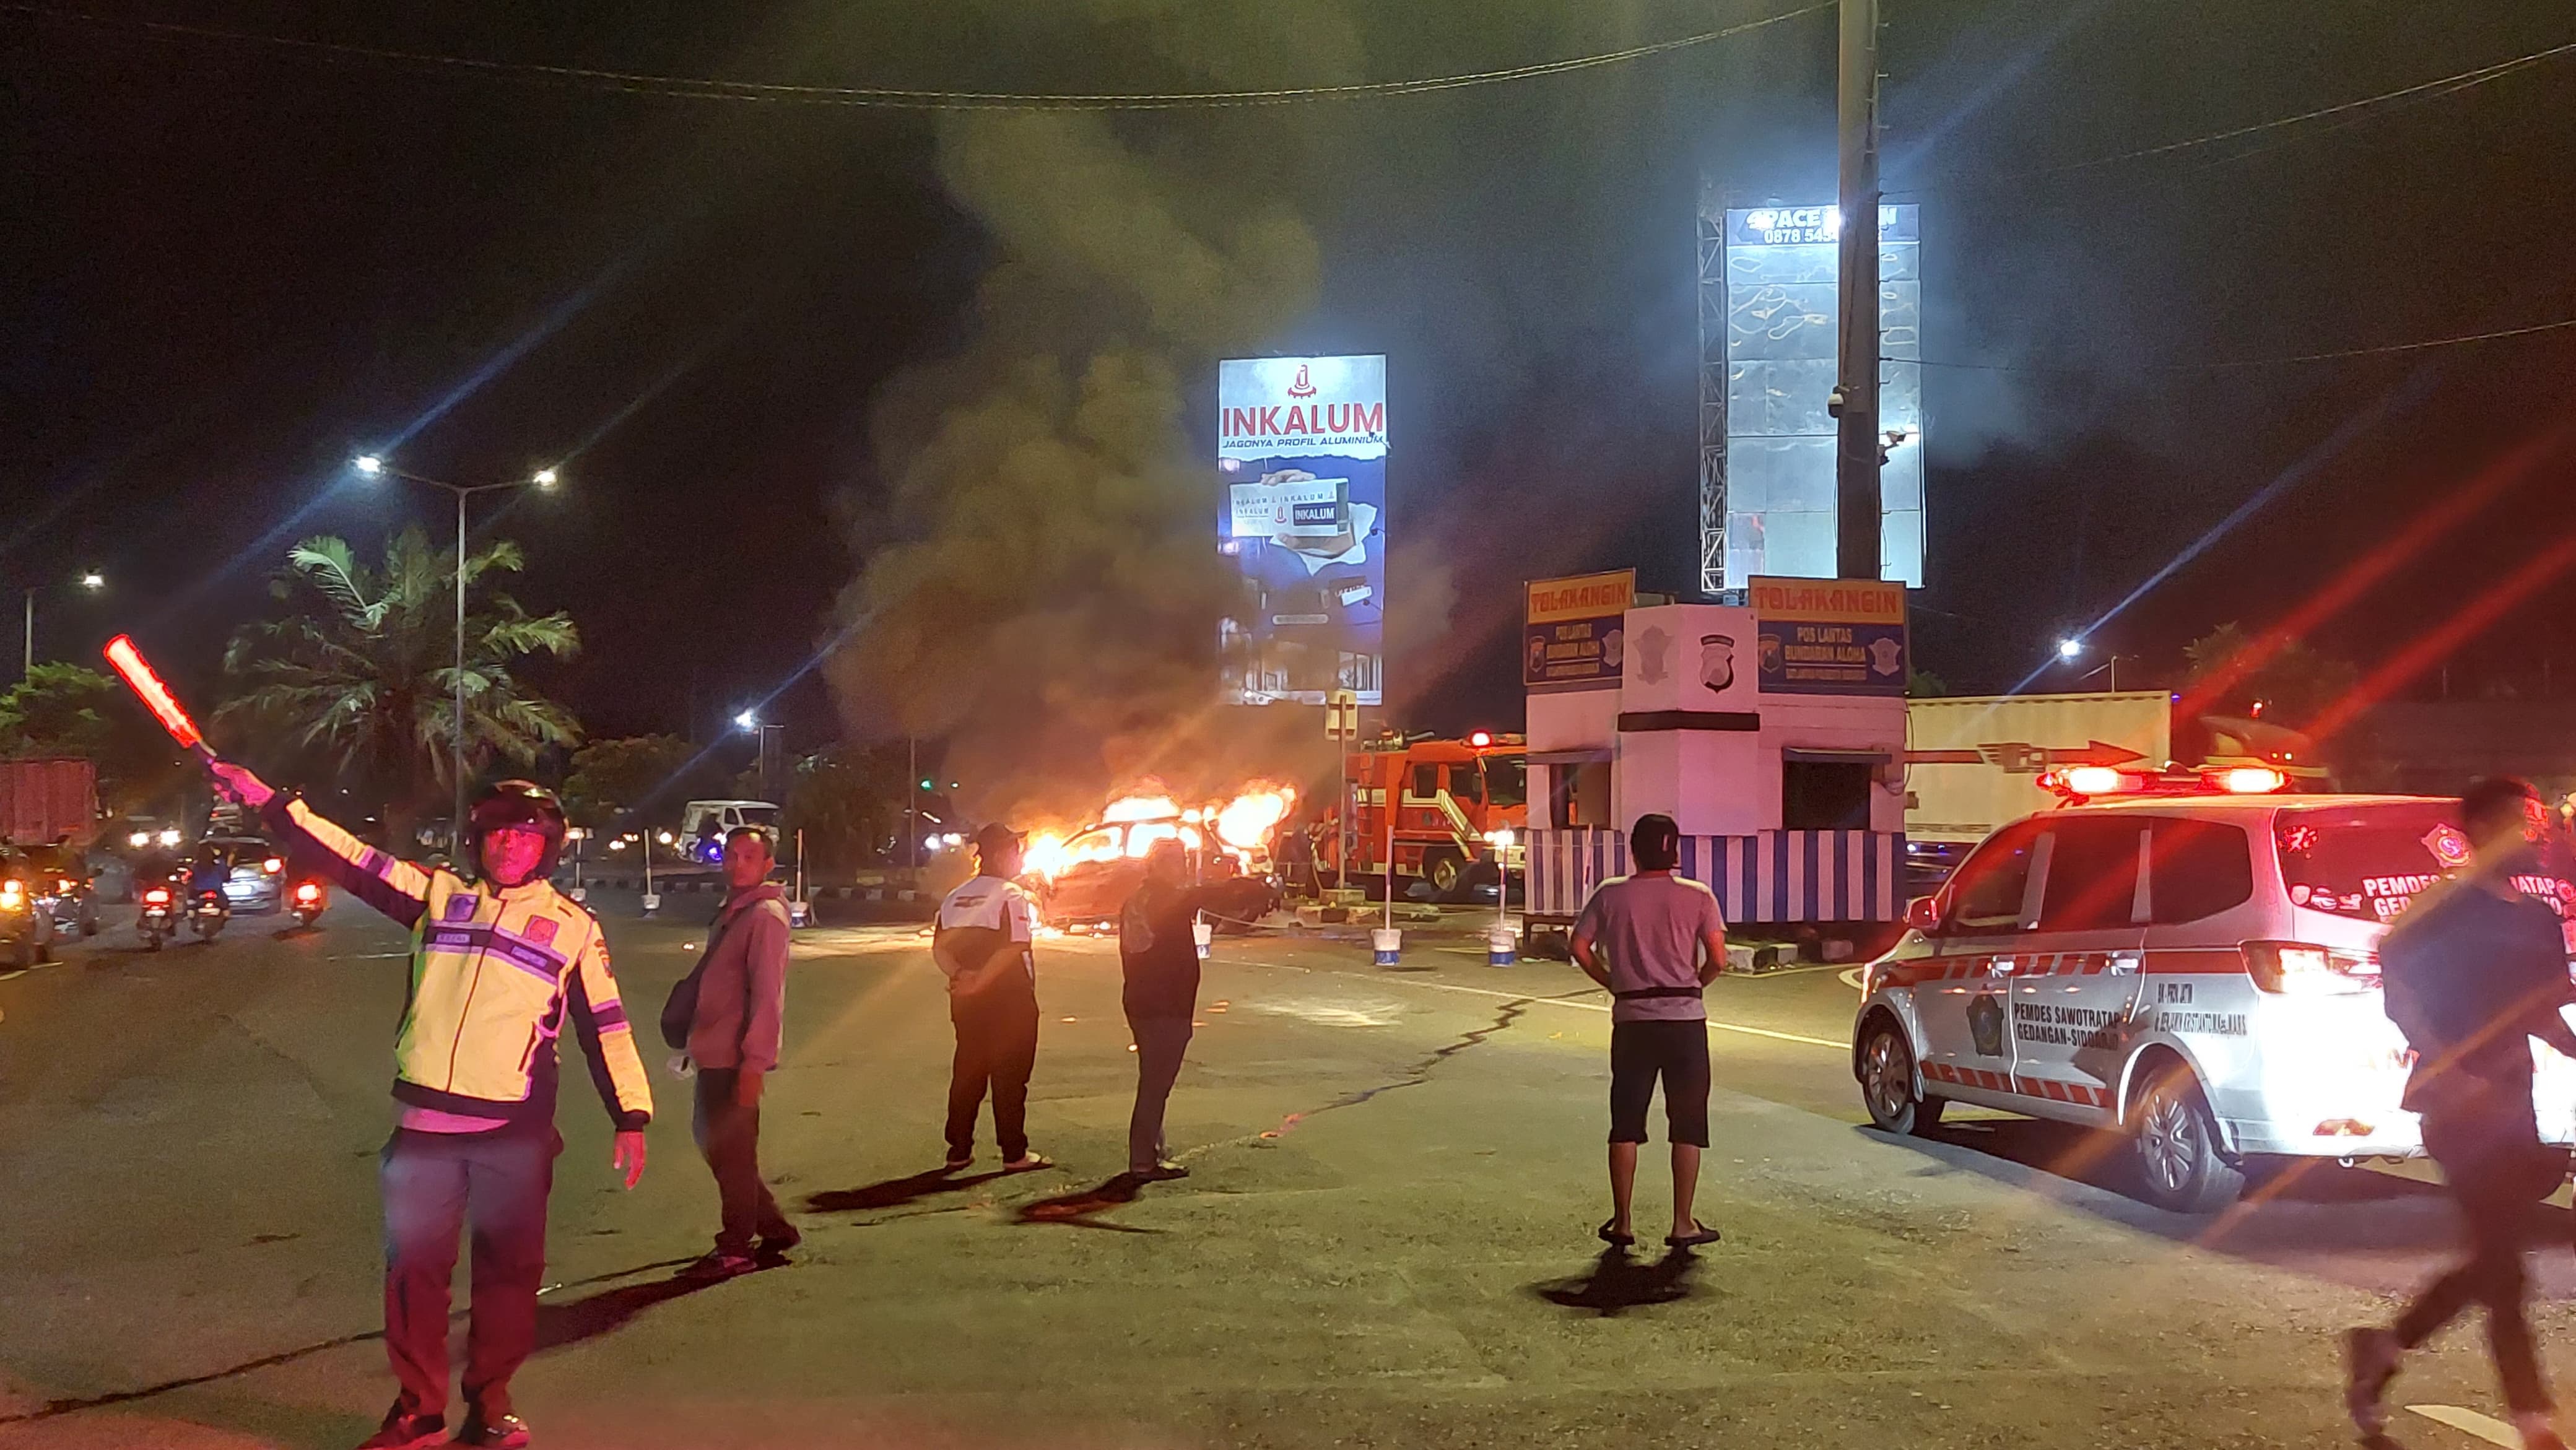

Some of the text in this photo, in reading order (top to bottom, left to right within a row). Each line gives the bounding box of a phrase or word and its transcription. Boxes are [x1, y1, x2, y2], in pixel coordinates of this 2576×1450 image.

[1764, 228, 1801, 243] 0878
[1222, 402, 1383, 437] INKALUM
[1222, 436, 1383, 448] JAGONYA PROFIL ALUMINIUM
[1280, 493, 1323, 503] INKALUM
[1295, 508, 1335, 520] INKALUM
[1797, 627, 1816, 642] POS
[2014, 1002, 2120, 1028] PEMDES SAWOTRATAP
